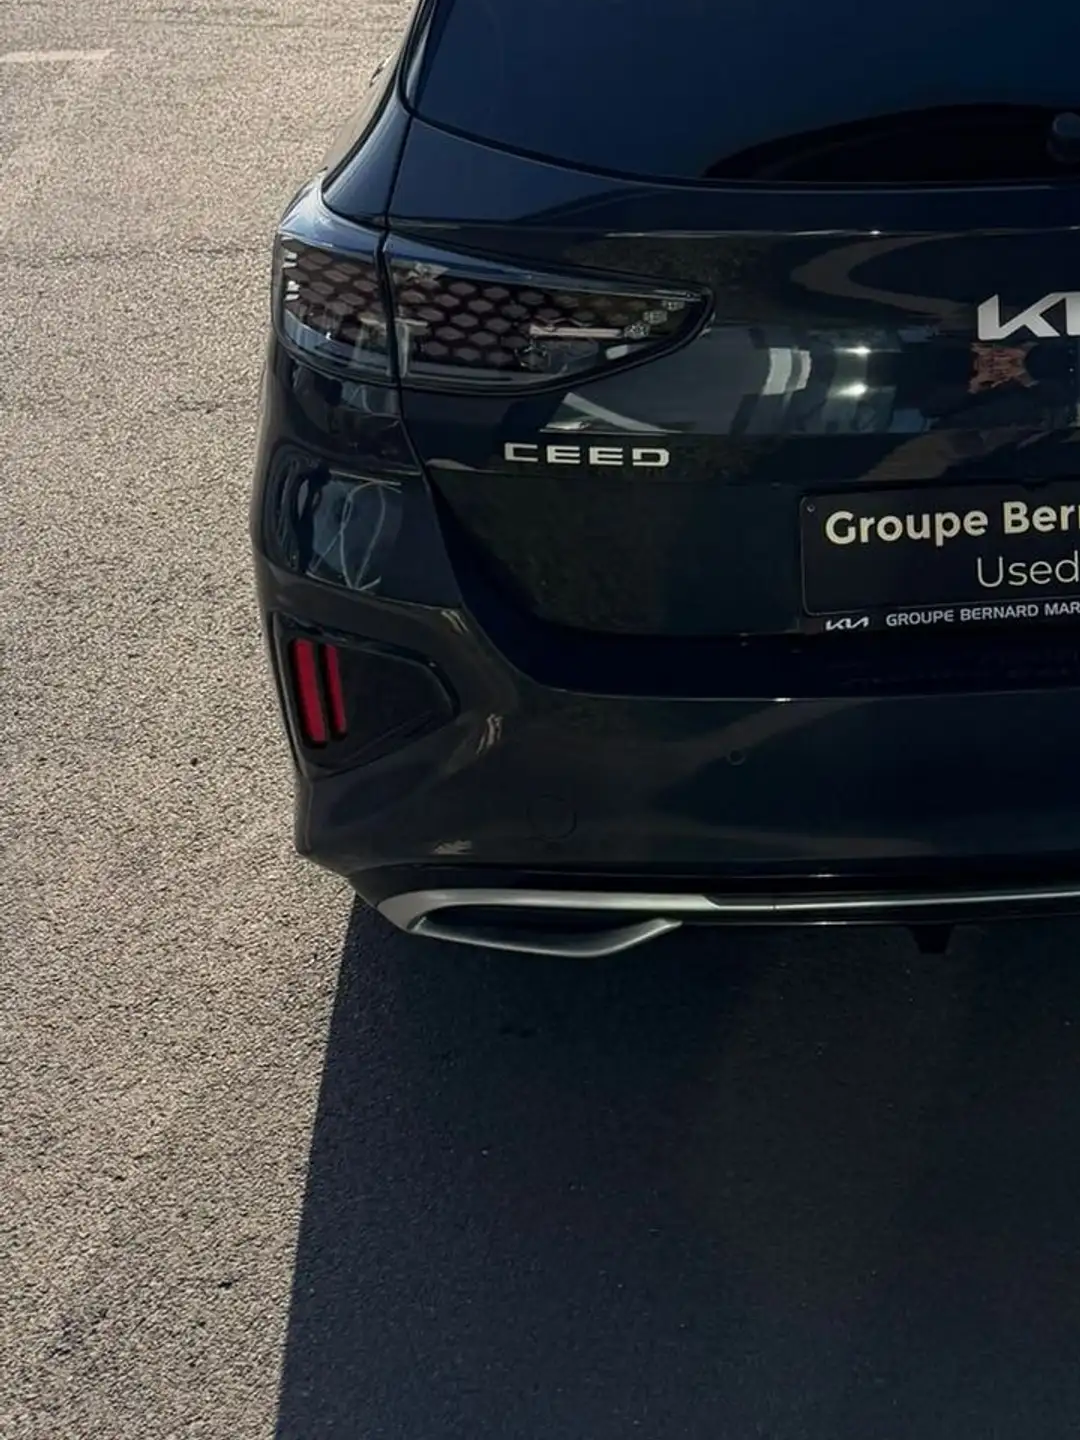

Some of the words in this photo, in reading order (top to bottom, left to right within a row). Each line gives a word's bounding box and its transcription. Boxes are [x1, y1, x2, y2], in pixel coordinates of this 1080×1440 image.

[504, 442, 670, 468] CEED
[825, 509, 989, 547] Groupe
[975, 549, 1080, 588] Used
[825, 615, 870, 631] KIA
[885, 609, 955, 627] GROUPE
[960, 603, 1039, 621] BERNARD
